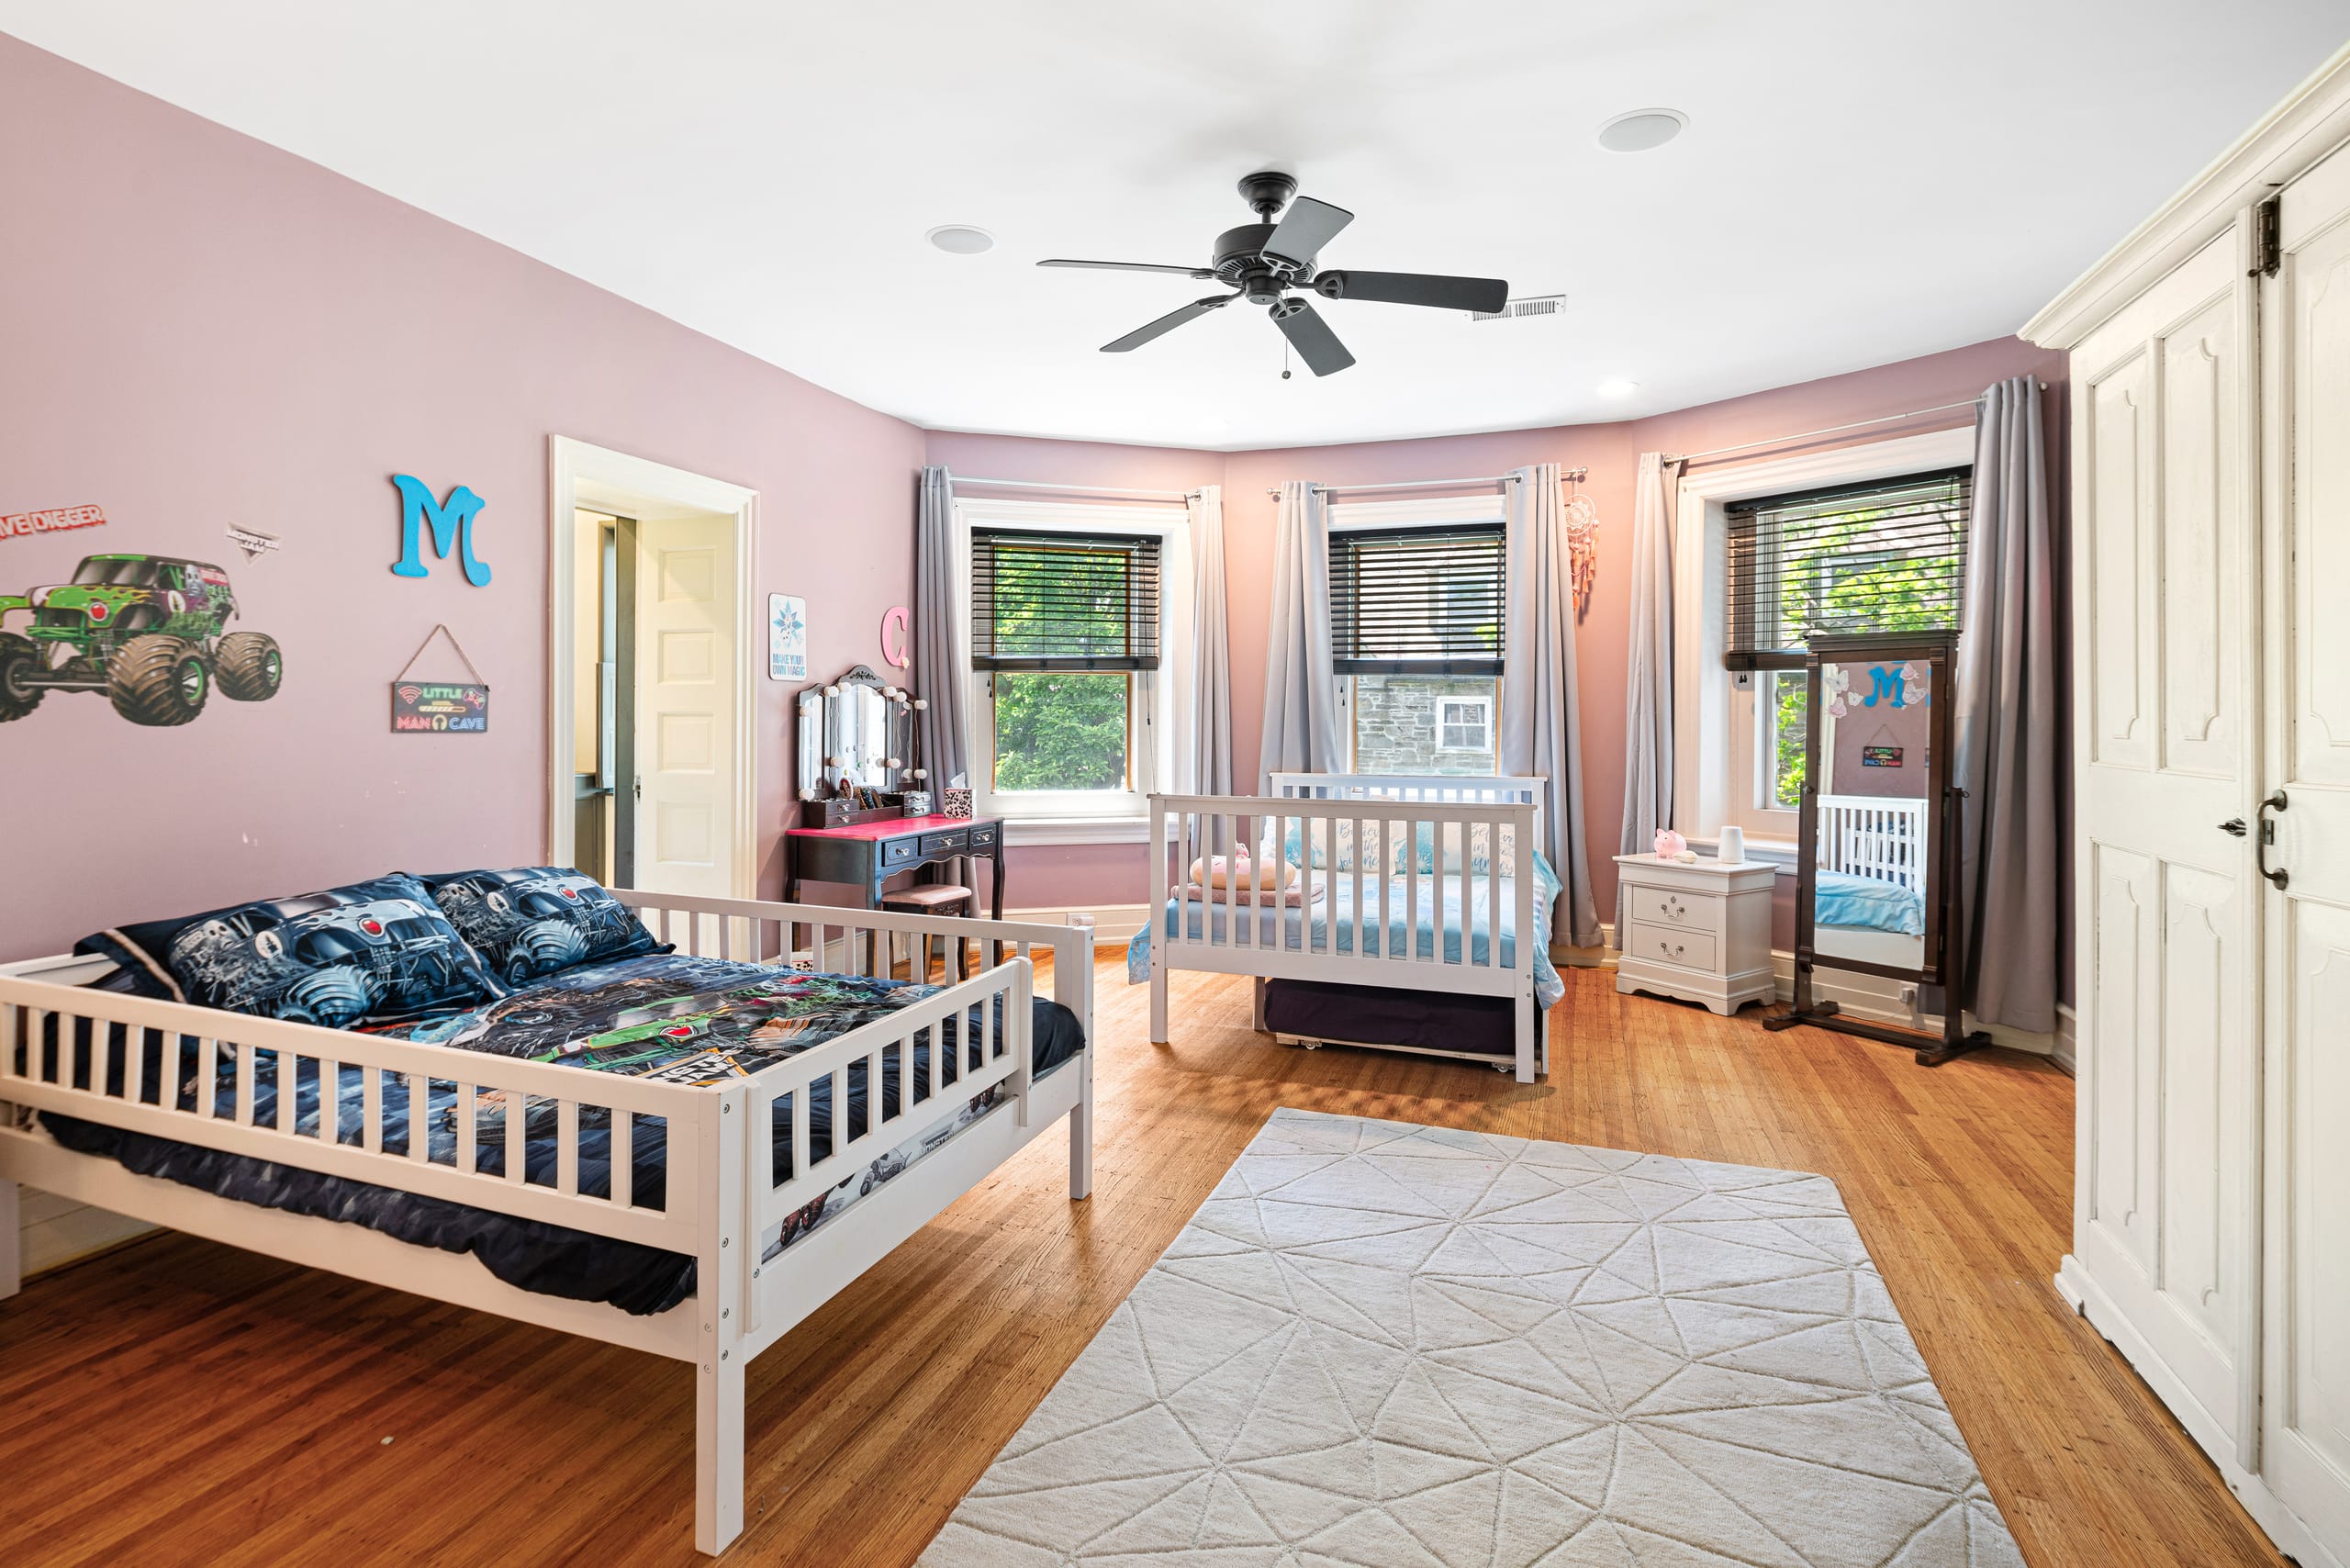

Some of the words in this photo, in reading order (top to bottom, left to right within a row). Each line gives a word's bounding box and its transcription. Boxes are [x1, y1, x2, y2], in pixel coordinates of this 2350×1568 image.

[31, 507, 104, 531] DIGGER
[393, 475, 491, 587] M
[880, 606, 909, 667] C
[772, 653, 789, 665] MAKE
[789, 654, 804, 666] YOUR
[772, 665, 787, 676] OWN
[787, 665, 806, 677] MAGIC
[422, 687, 463, 699] LITTLE
[397, 716, 431, 730] MAN
[448, 717, 486, 730] CAVE
